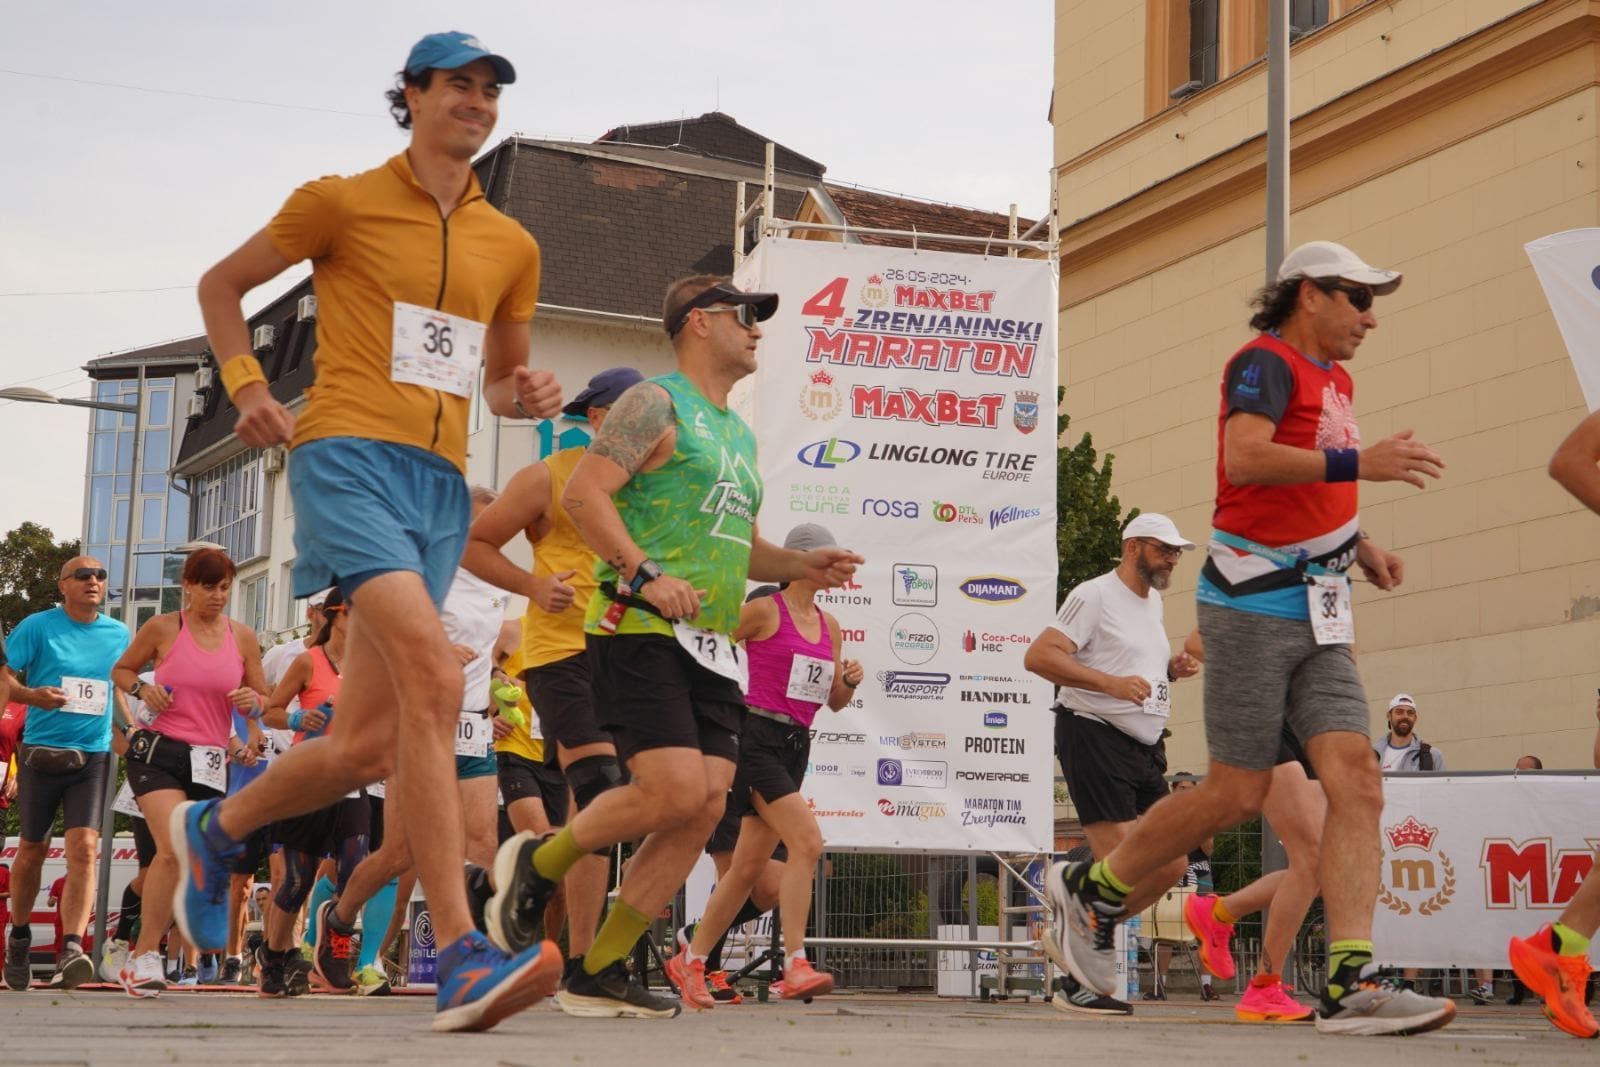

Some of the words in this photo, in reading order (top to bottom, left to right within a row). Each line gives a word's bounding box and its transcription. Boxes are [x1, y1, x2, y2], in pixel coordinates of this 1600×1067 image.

[853, 308, 1043, 342] ZRENJANINSKI
[423, 321, 454, 358] 36
[804, 327, 1037, 378] MARATON
[868, 443, 979, 467] LINGLONG
[986, 452, 1037, 471] TIRE
[982, 470, 1031, 483] EUROPE
[862, 499, 920, 519] rosa
[959, 506, 977, 515] DTL
[989, 505, 1041, 530] Wellness
[968, 583, 1019, 597] DIJAMANT
[982, 633, 1031, 644] Coca-Cola
[982, 643, 1003, 652] HBC
[807, 664, 823, 684] 12
[77, 683, 94, 700] 16
[960, 690, 1031, 704] HANDFUL
[818, 732, 867, 742] FORCE
[965, 736, 1025, 755] PROTEIN
[206, 751, 222, 770] 39
[956, 771, 1031, 783] POWERADE
[896, 803, 947, 822] magus
[964, 798, 1004, 810] MARATON
[1007, 800, 1022, 811] TIM
[960, 810, 1027, 828] Zrenjanin
[1479, 837, 1600, 910] MA
